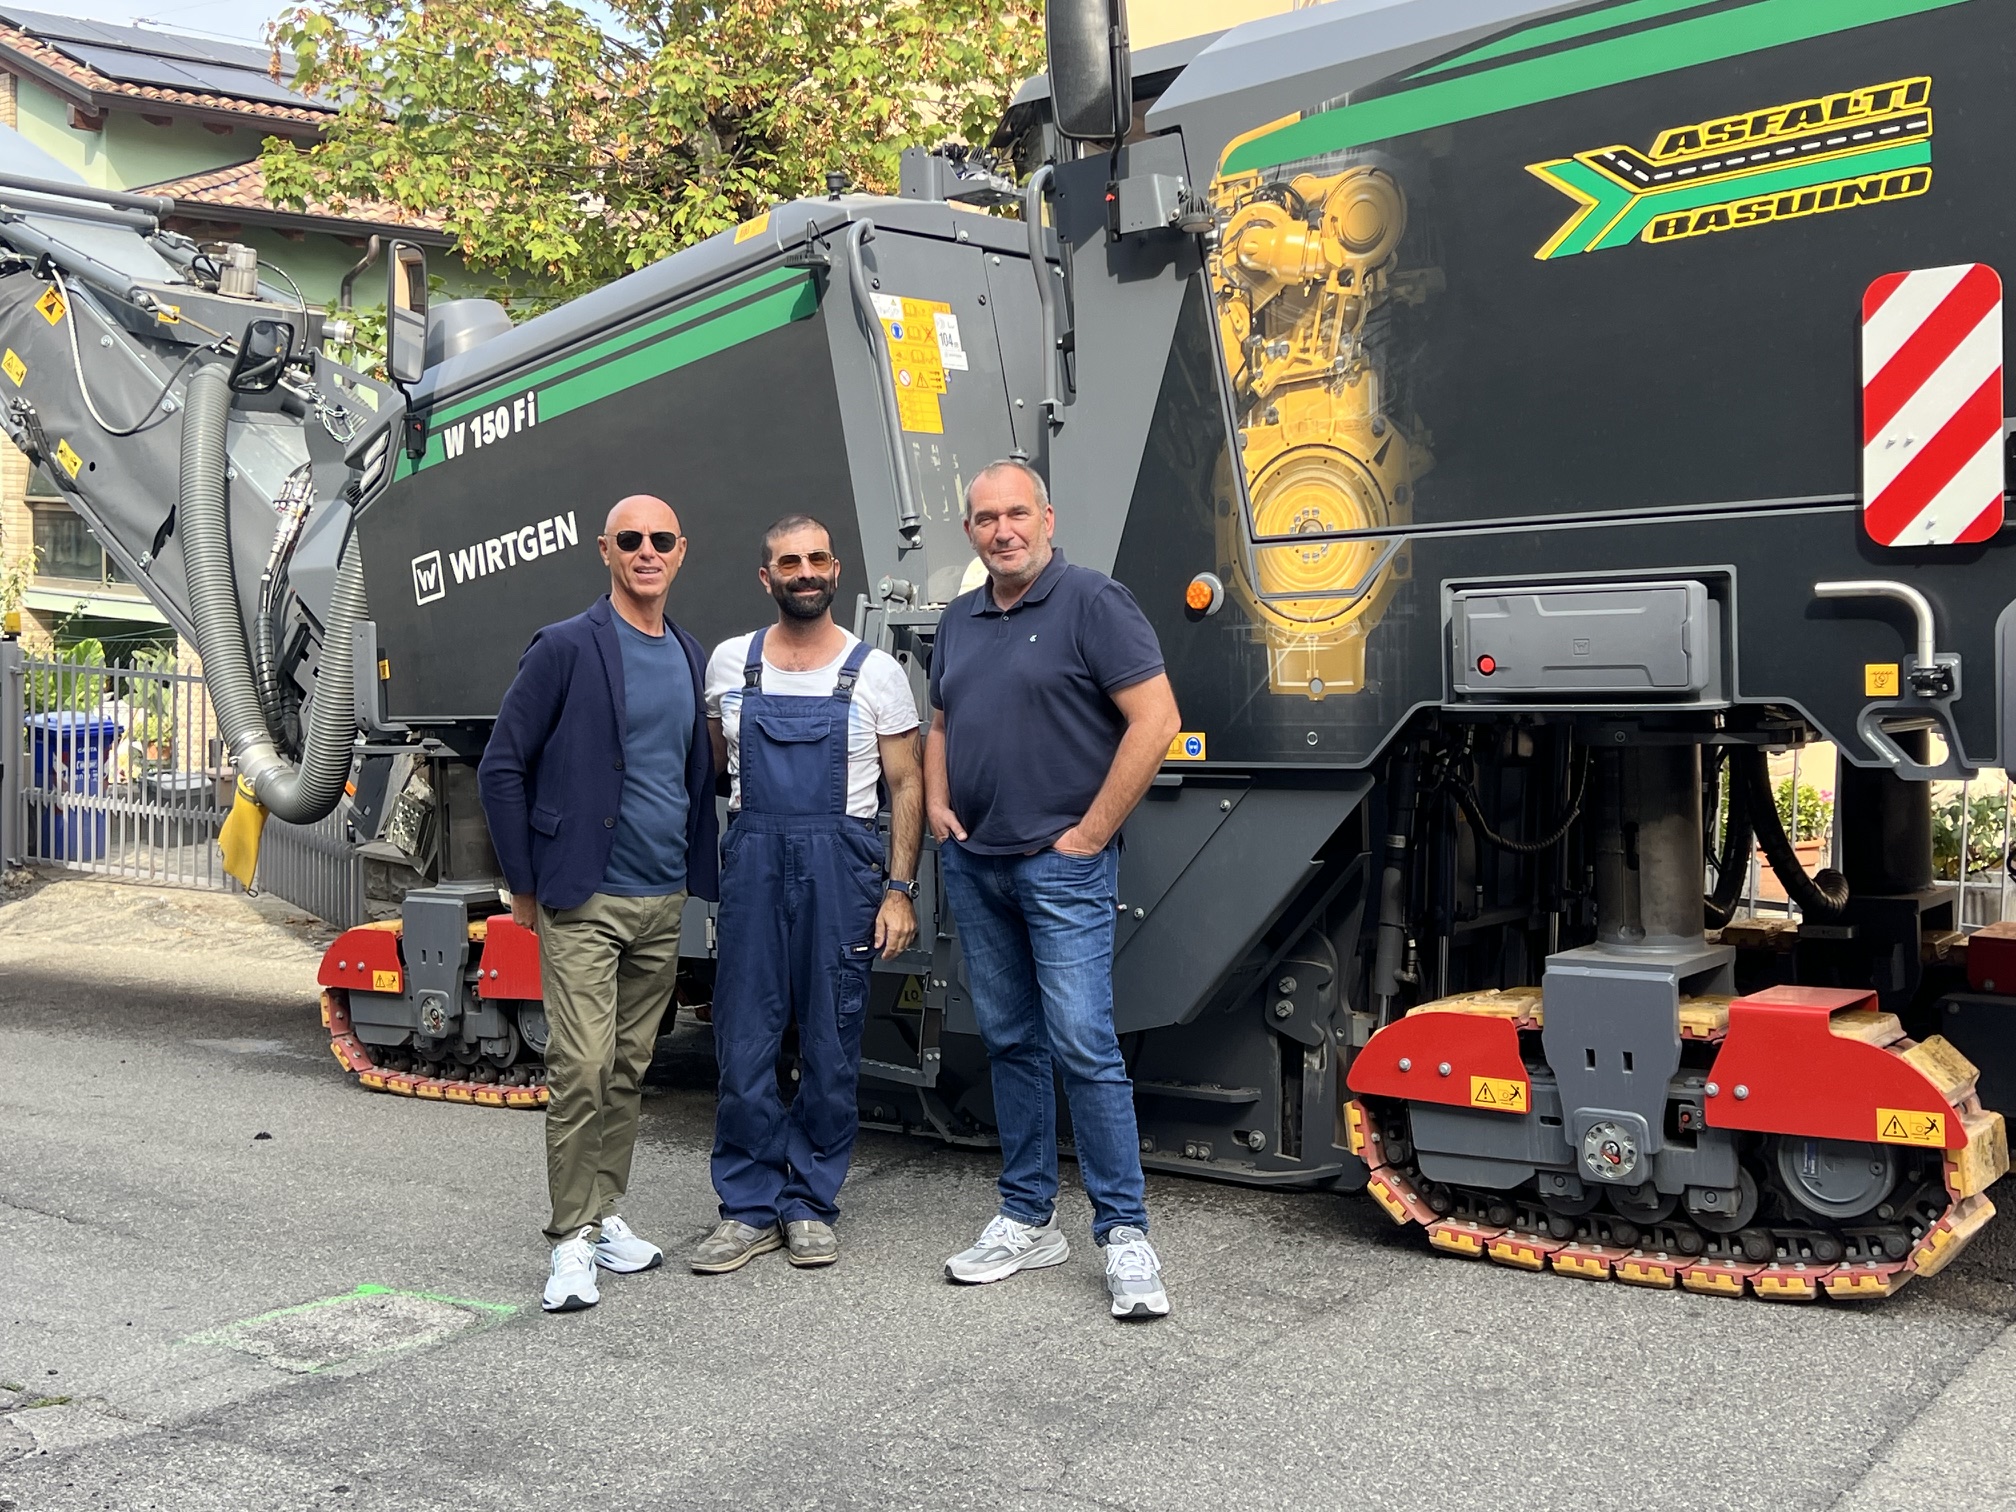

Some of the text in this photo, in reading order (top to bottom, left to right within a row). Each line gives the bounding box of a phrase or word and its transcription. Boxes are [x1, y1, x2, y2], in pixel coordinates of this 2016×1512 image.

[1650, 76, 1932, 160] ASFALTI
[1641, 167, 1932, 243] BASUINO
[939, 332, 953, 348] 104
[444, 391, 536, 459] W 150 Fi
[449, 510, 579, 584] WIRTGEN
